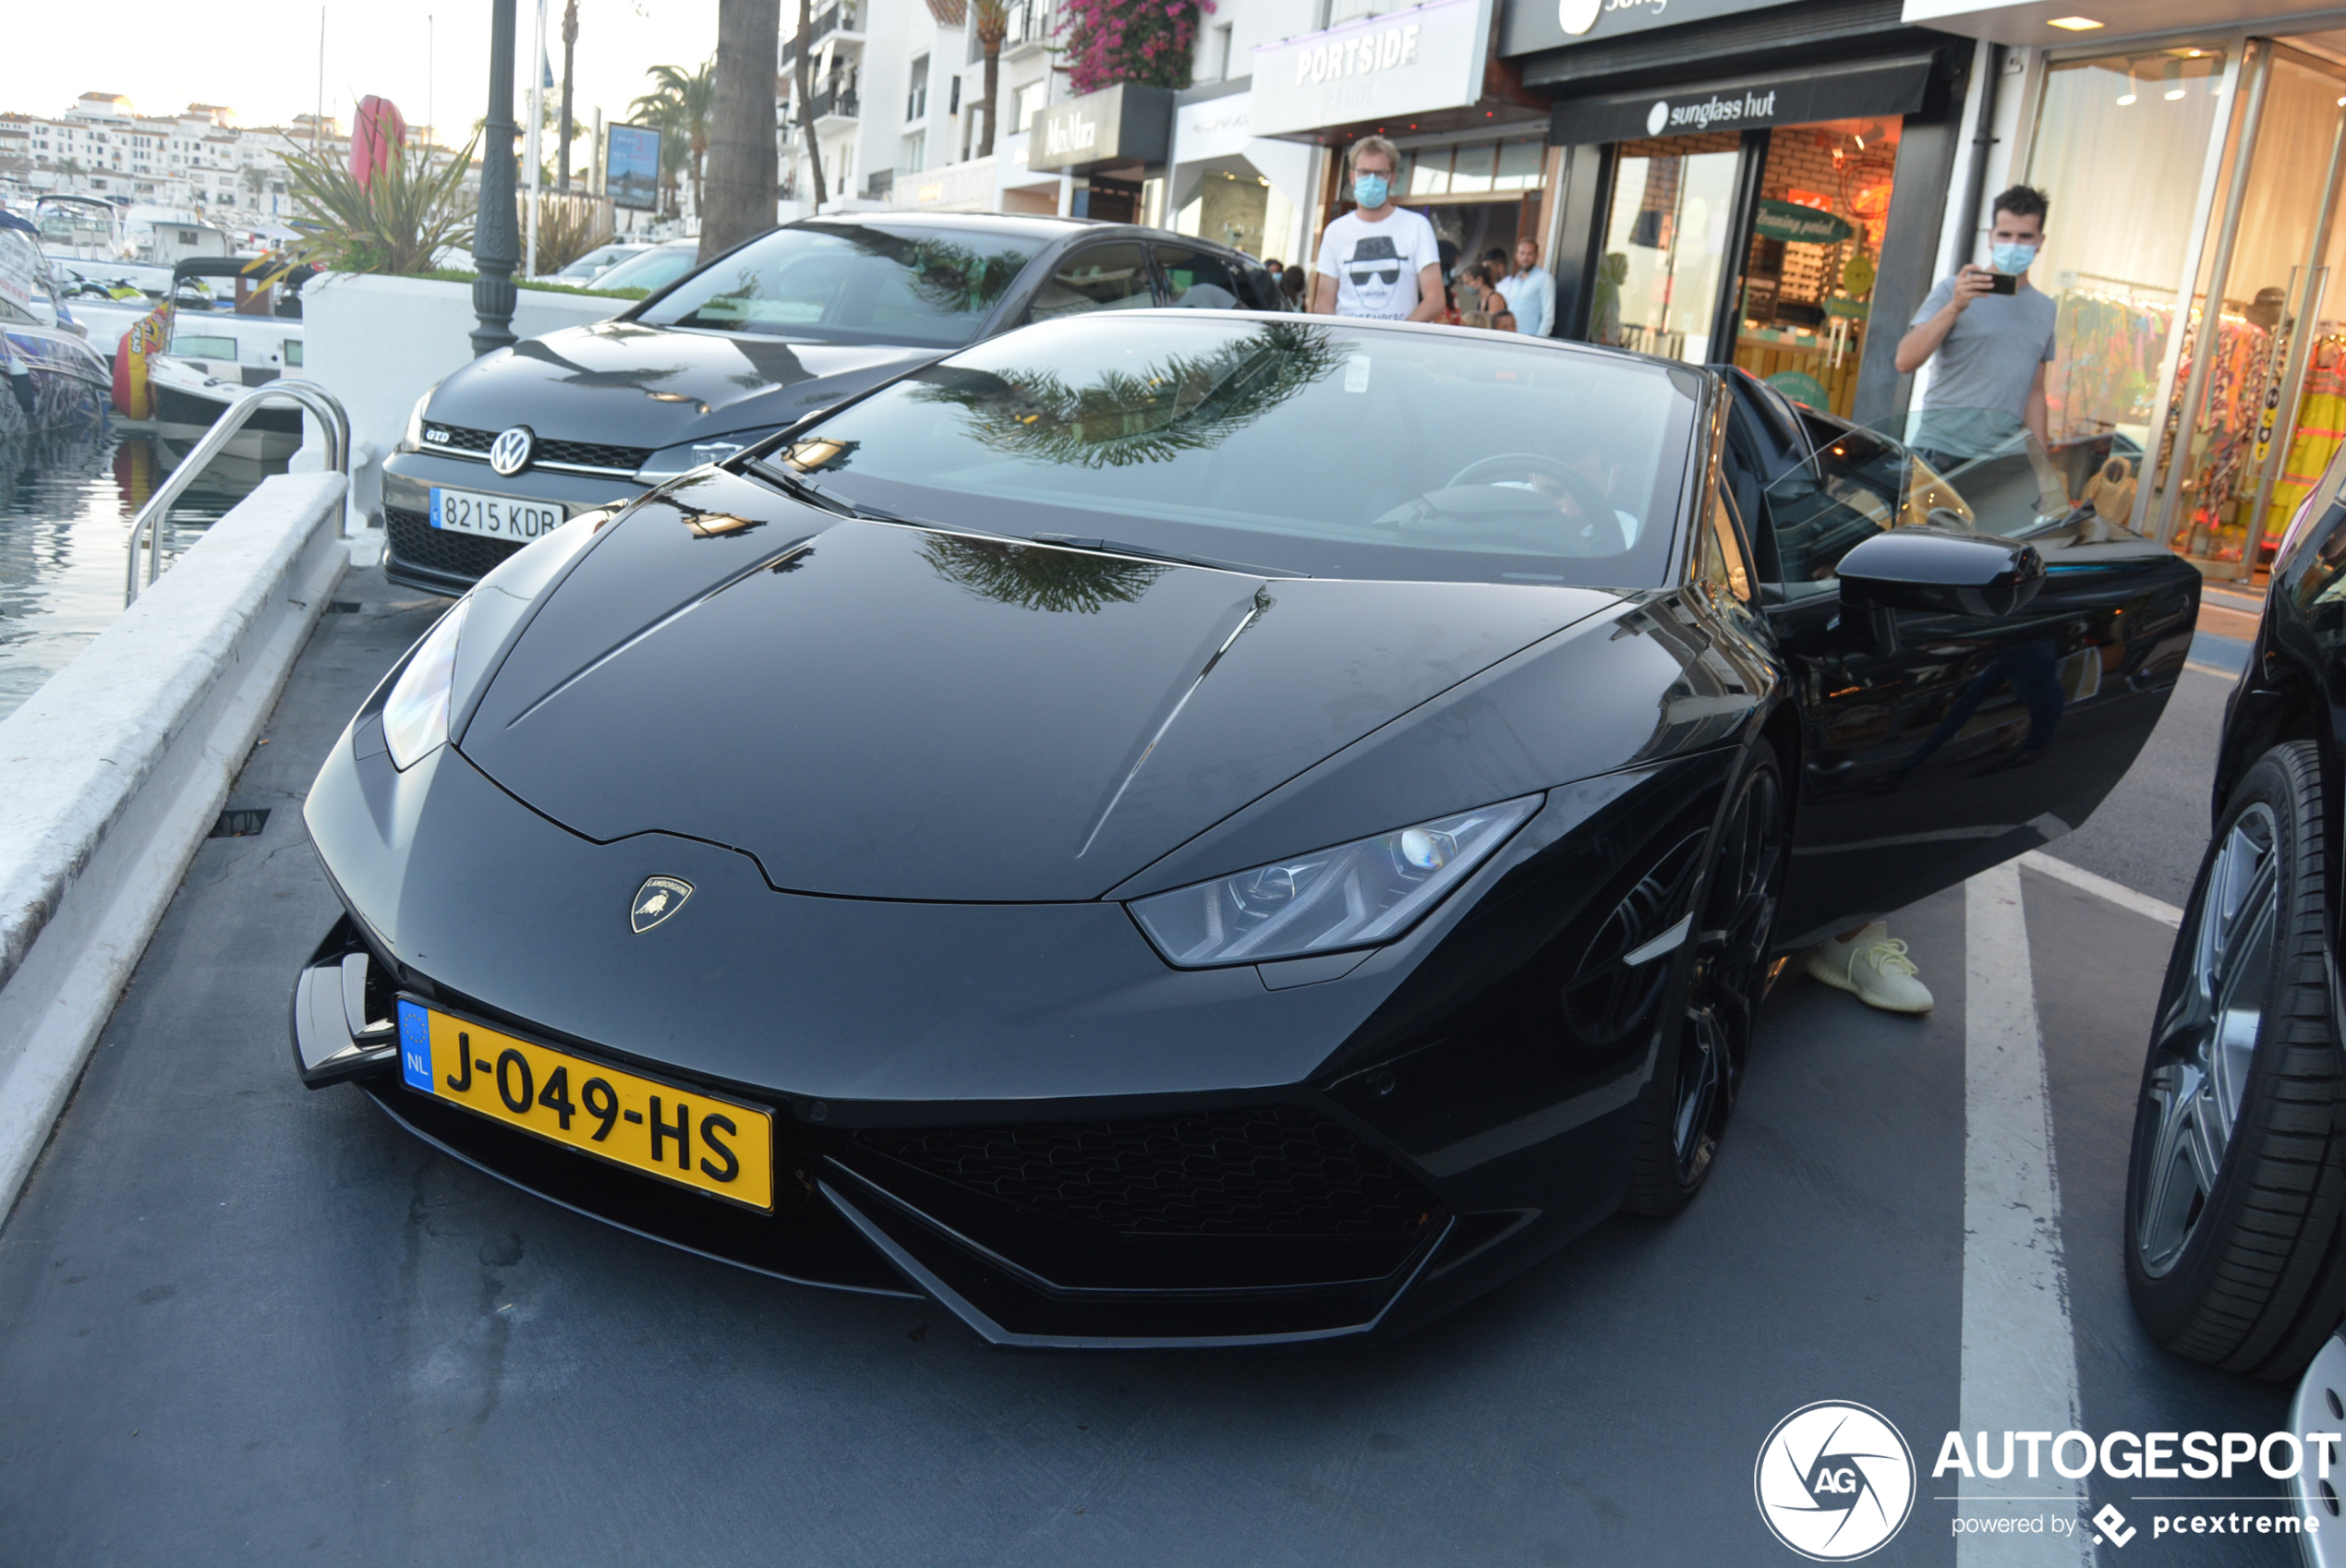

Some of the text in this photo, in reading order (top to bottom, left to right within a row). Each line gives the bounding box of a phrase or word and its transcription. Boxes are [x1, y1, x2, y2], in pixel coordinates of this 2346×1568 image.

[1297, 23, 1421, 88] PORTSIDE
[1669, 90, 1776, 130] sunglass hut
[426, 428, 450, 444] GTD
[445, 496, 501, 533] 8215
[647, 879, 689, 897] LAMBORGHINI
[407, 1052, 429, 1076] NL
[447, 1031, 740, 1183] J-049-HS
